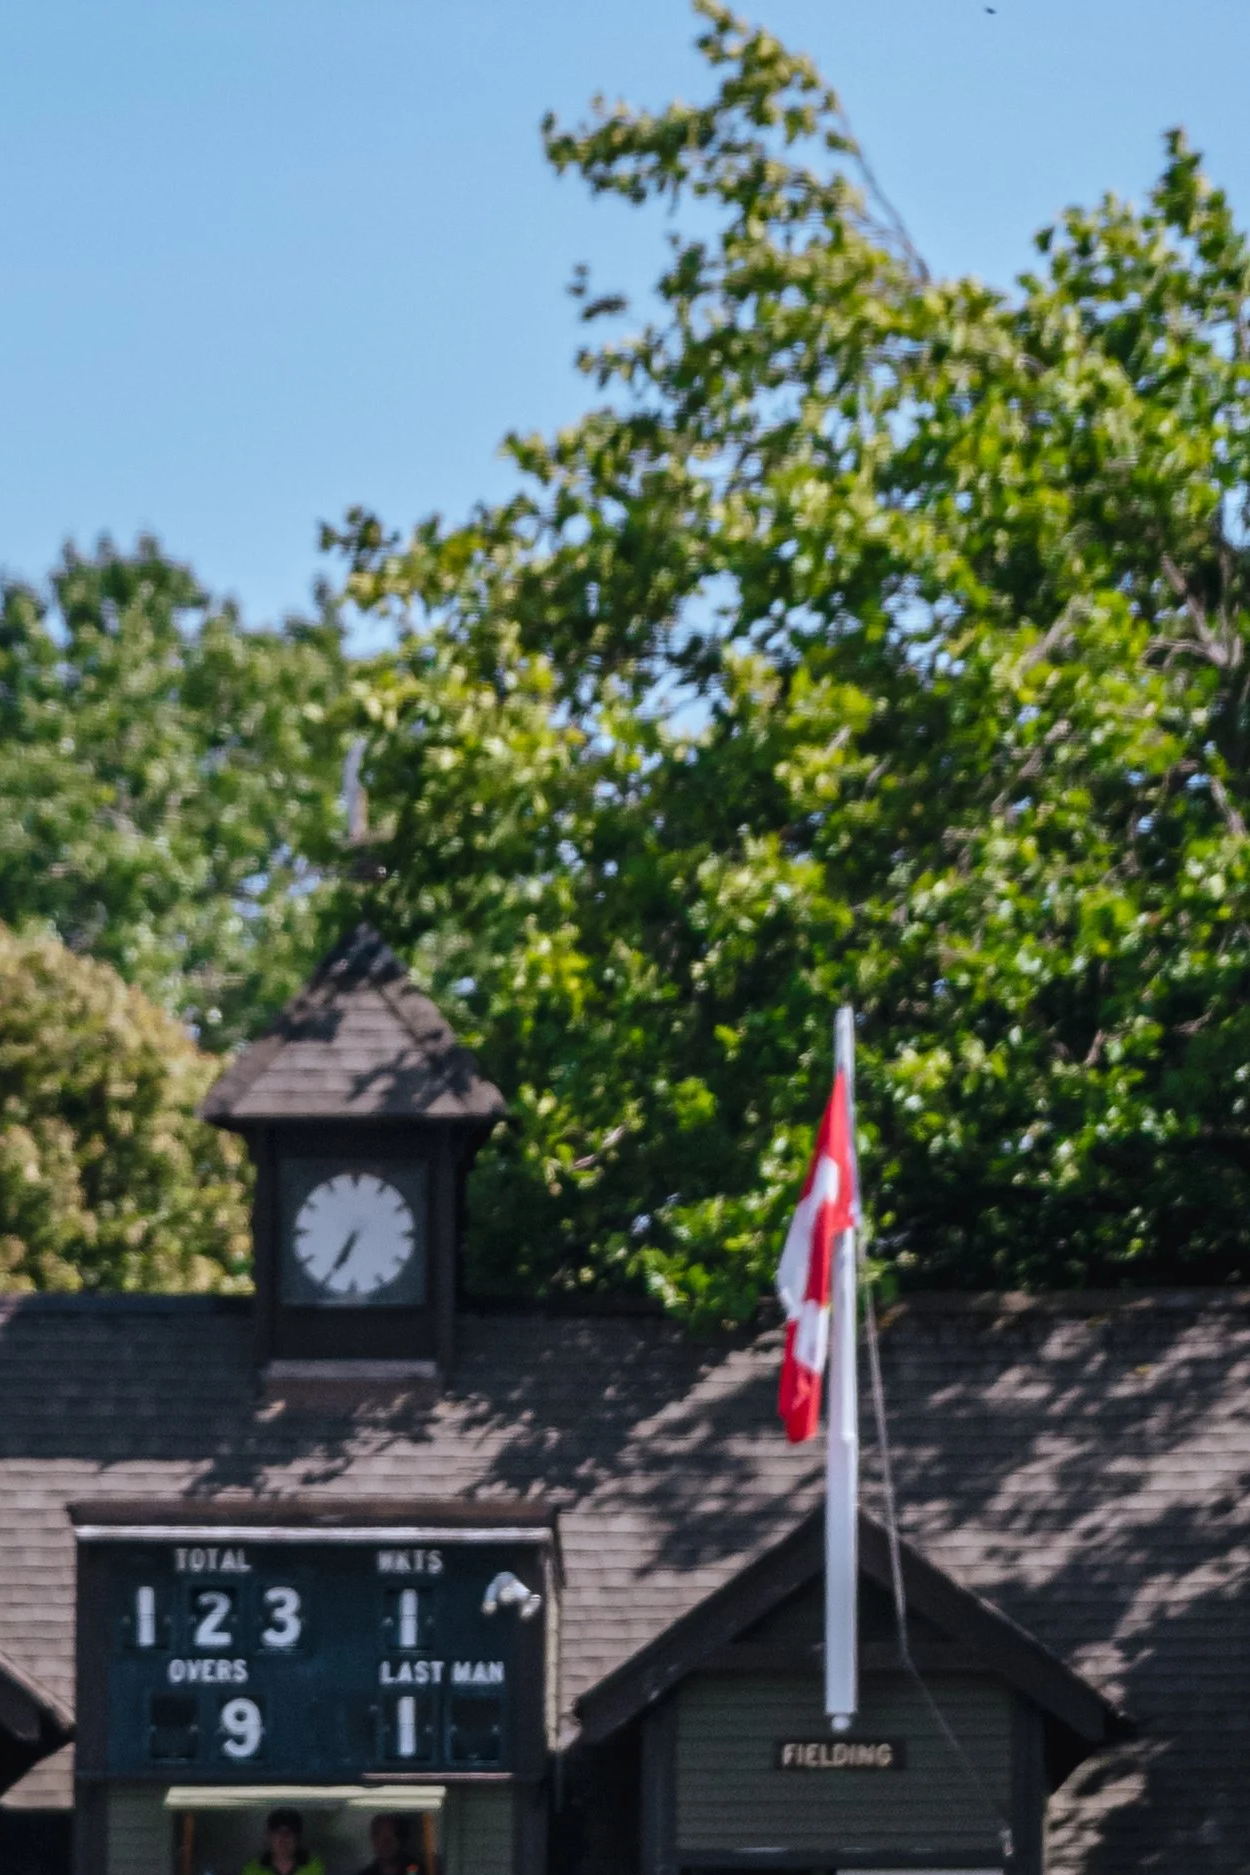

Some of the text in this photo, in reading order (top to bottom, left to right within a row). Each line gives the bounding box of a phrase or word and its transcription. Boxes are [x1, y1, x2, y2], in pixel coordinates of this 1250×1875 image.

[175, 1547, 251, 1573] TOTAL
[400, 1588, 418, 1648] 1
[167, 1658, 249, 1684] OVERS
[379, 1660, 505, 1684] LAST MAN
[220, 1697, 263, 1758] 9
[397, 1696, 416, 1757] 1
[782, 1742, 892, 1768] FIELDING
